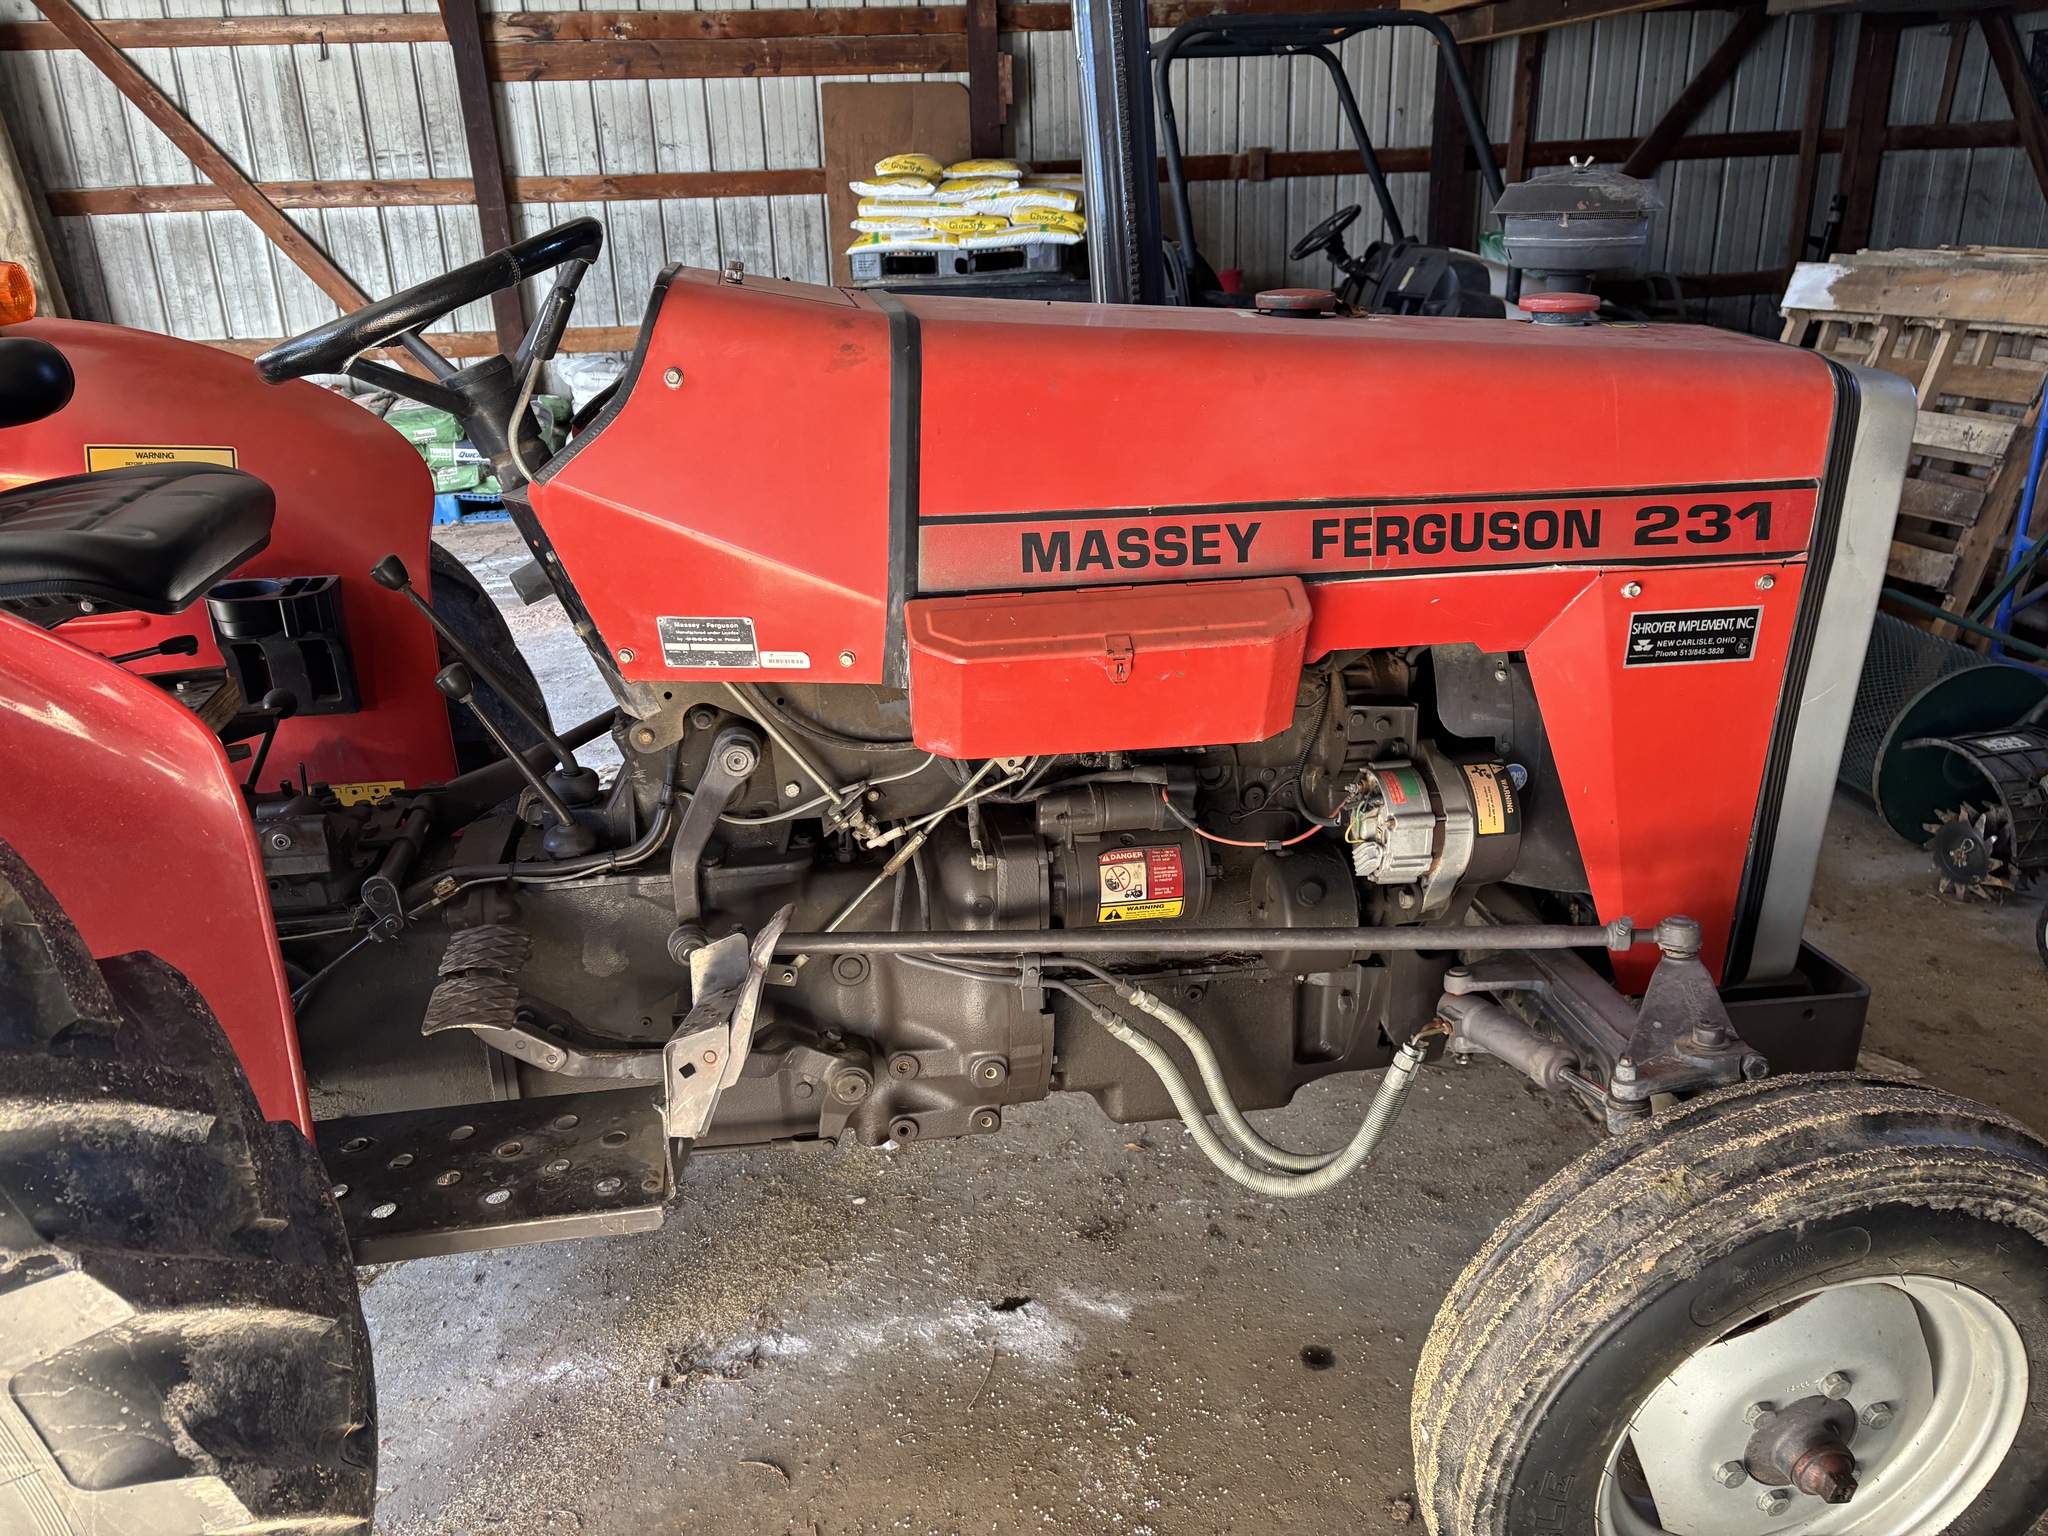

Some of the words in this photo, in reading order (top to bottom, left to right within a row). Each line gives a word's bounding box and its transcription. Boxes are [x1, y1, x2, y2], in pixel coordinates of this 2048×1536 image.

[458, 451, 481, 459] QUIC
[1021, 521, 1262, 574] MASSEY
[1311, 508, 1602, 560] FERGUSON
[1633, 501, 1772, 547] 231
[673, 621, 700, 629] Massey
[1631, 621, 1677, 635] SHROYER
[1677, 617, 1735, 632] IMPLEMENT,
[1736, 617, 1755, 630] INC.
[1656, 639, 1676, 648] NEW
[1716, 636, 1737, 645] OHIO
[1655, 650, 1678, 658] Phone
[1501, 778, 1514, 814] WARNING
[1110, 851, 1144, 861] DANGER
